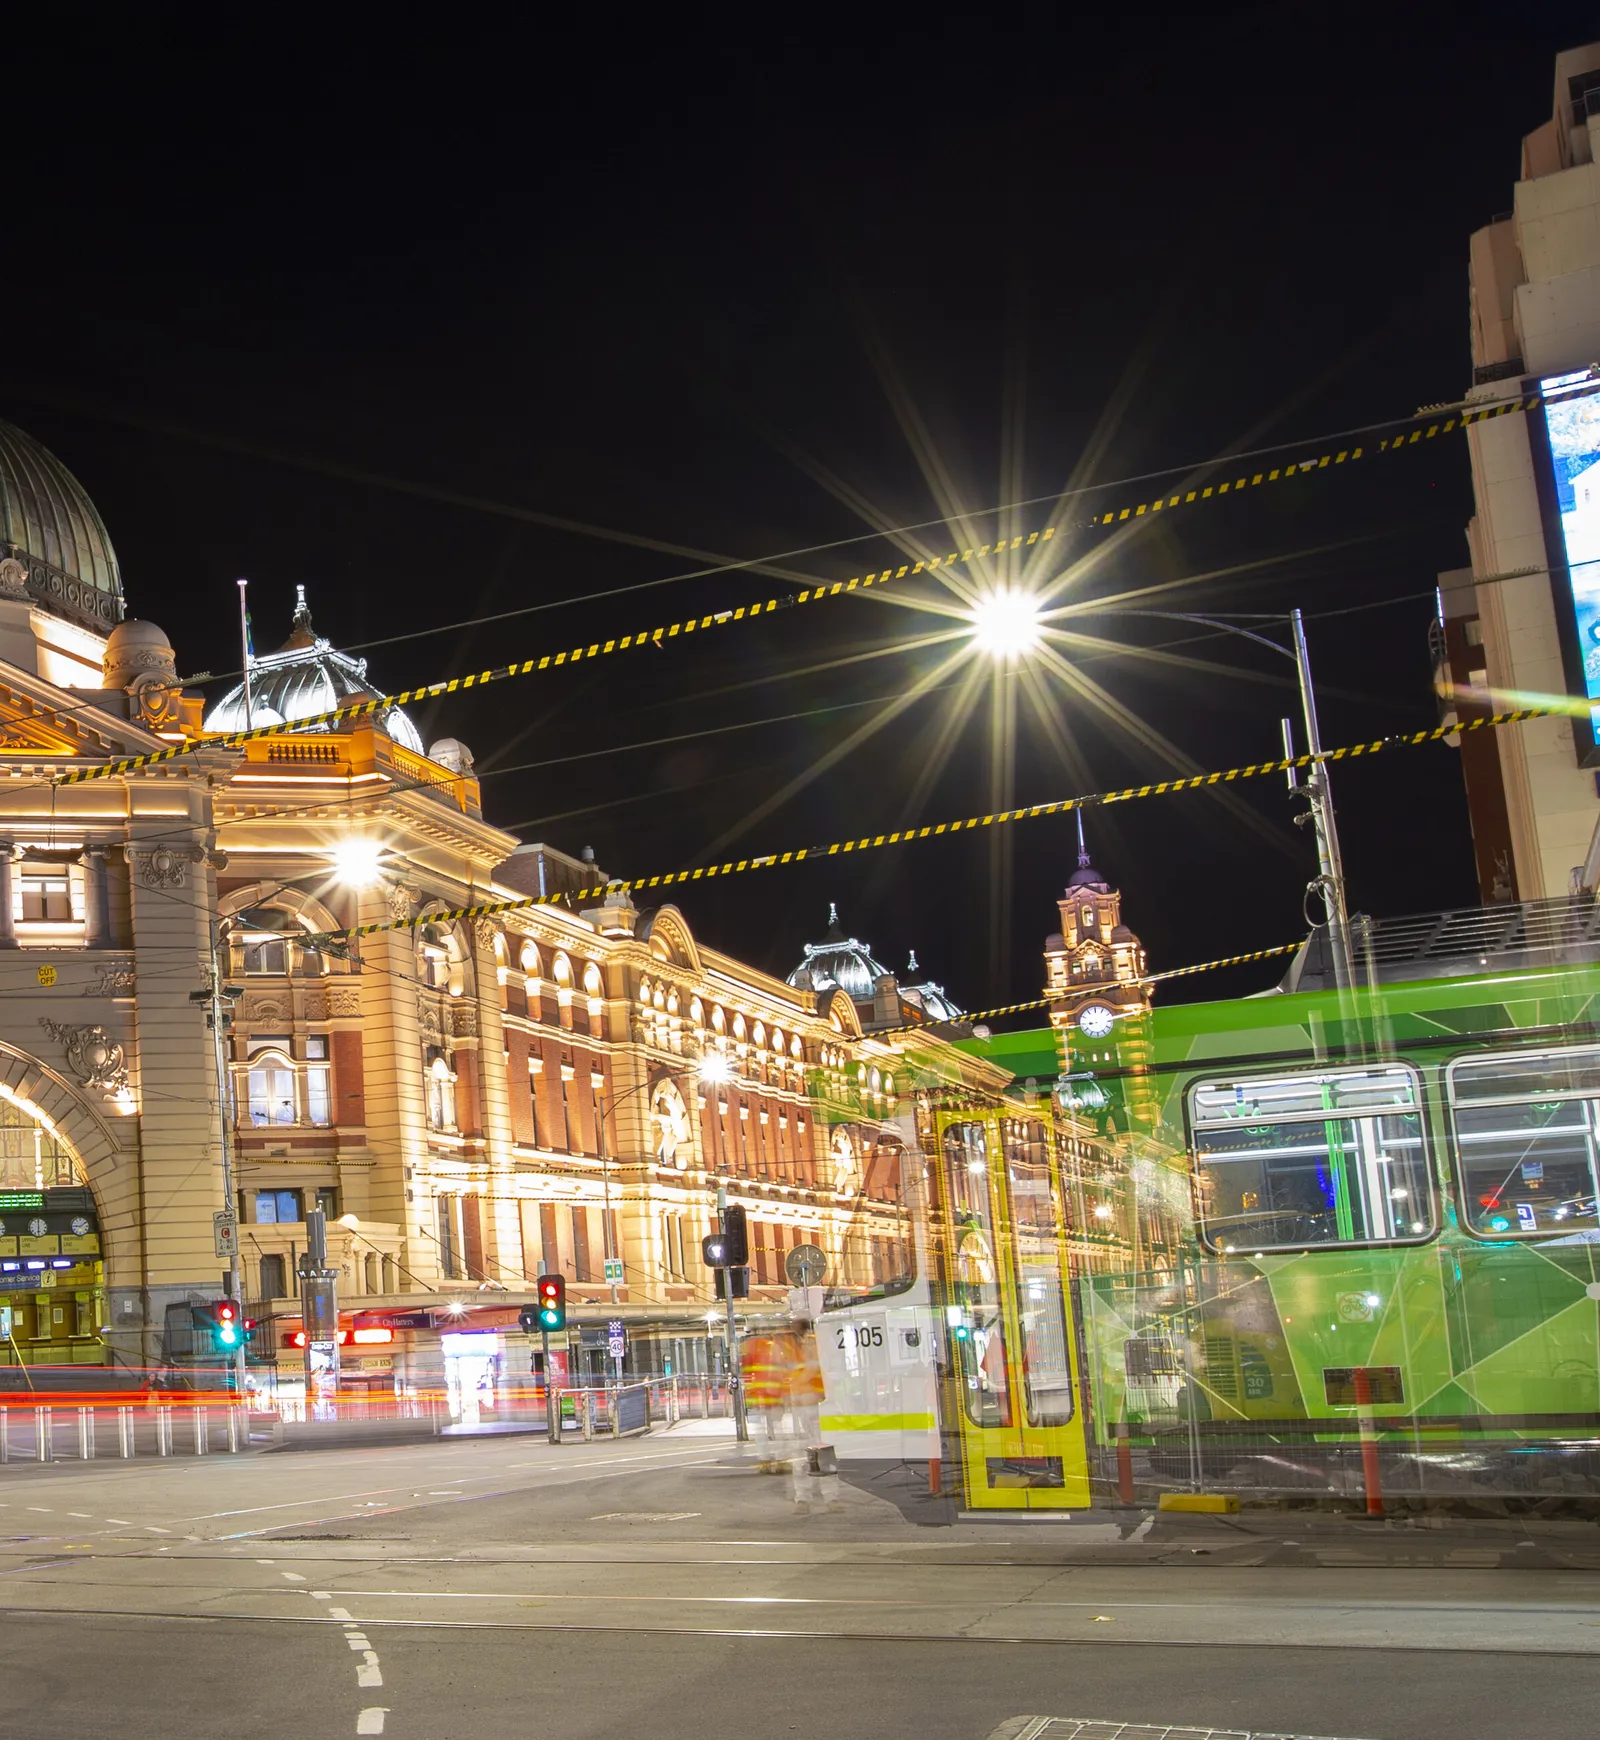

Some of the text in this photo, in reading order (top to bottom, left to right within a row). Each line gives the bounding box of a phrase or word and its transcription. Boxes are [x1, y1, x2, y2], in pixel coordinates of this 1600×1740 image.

[39, 968, 53, 976] CUT
[40, 977, 55, 985] OFF
[16, 1274, 40, 1282] Service
[611, 1343, 621, 1351] 40
